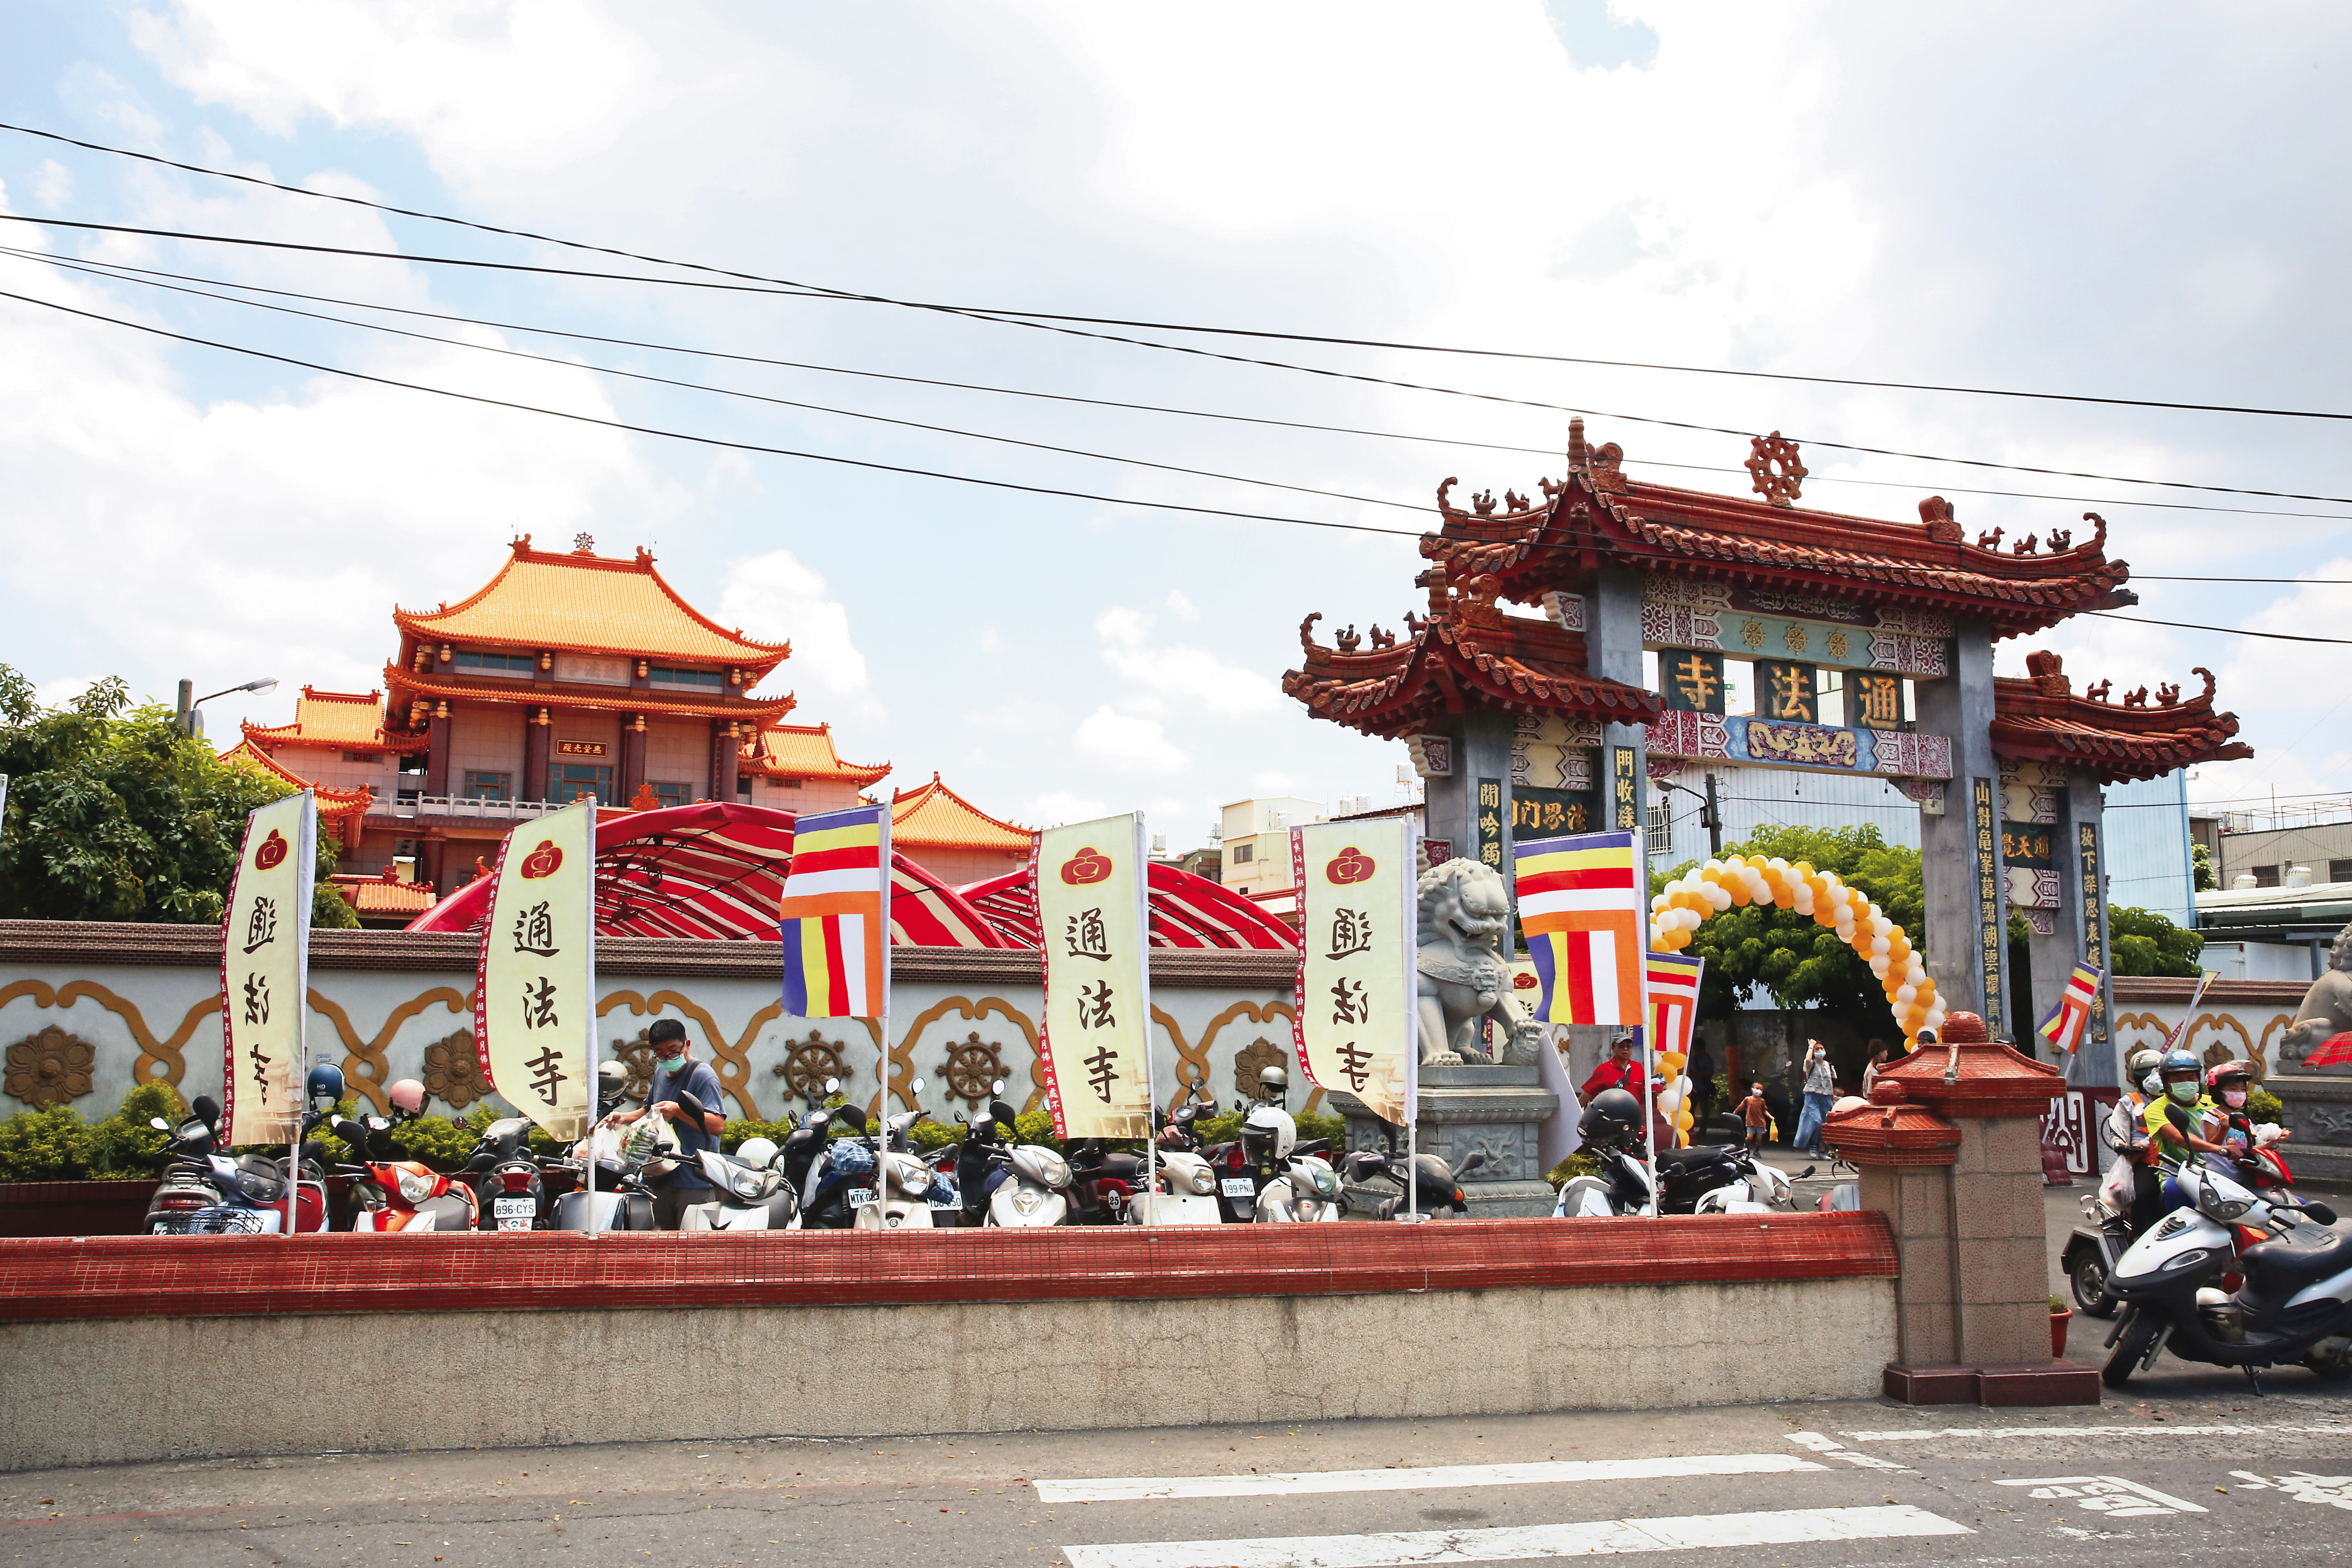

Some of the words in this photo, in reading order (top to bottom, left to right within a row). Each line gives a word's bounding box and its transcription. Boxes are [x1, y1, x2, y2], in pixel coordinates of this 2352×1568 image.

[1676, 654, 1898, 730] 通法寺
[1479, 783, 1501, 866] 閒吟獨
[513, 901, 568, 1106] 通法寺
[1065, 907, 1119, 1104] 通法寺
[850, 1192, 873, 1204] MTK-0
[1109, 1196, 1119, 1205] 25
